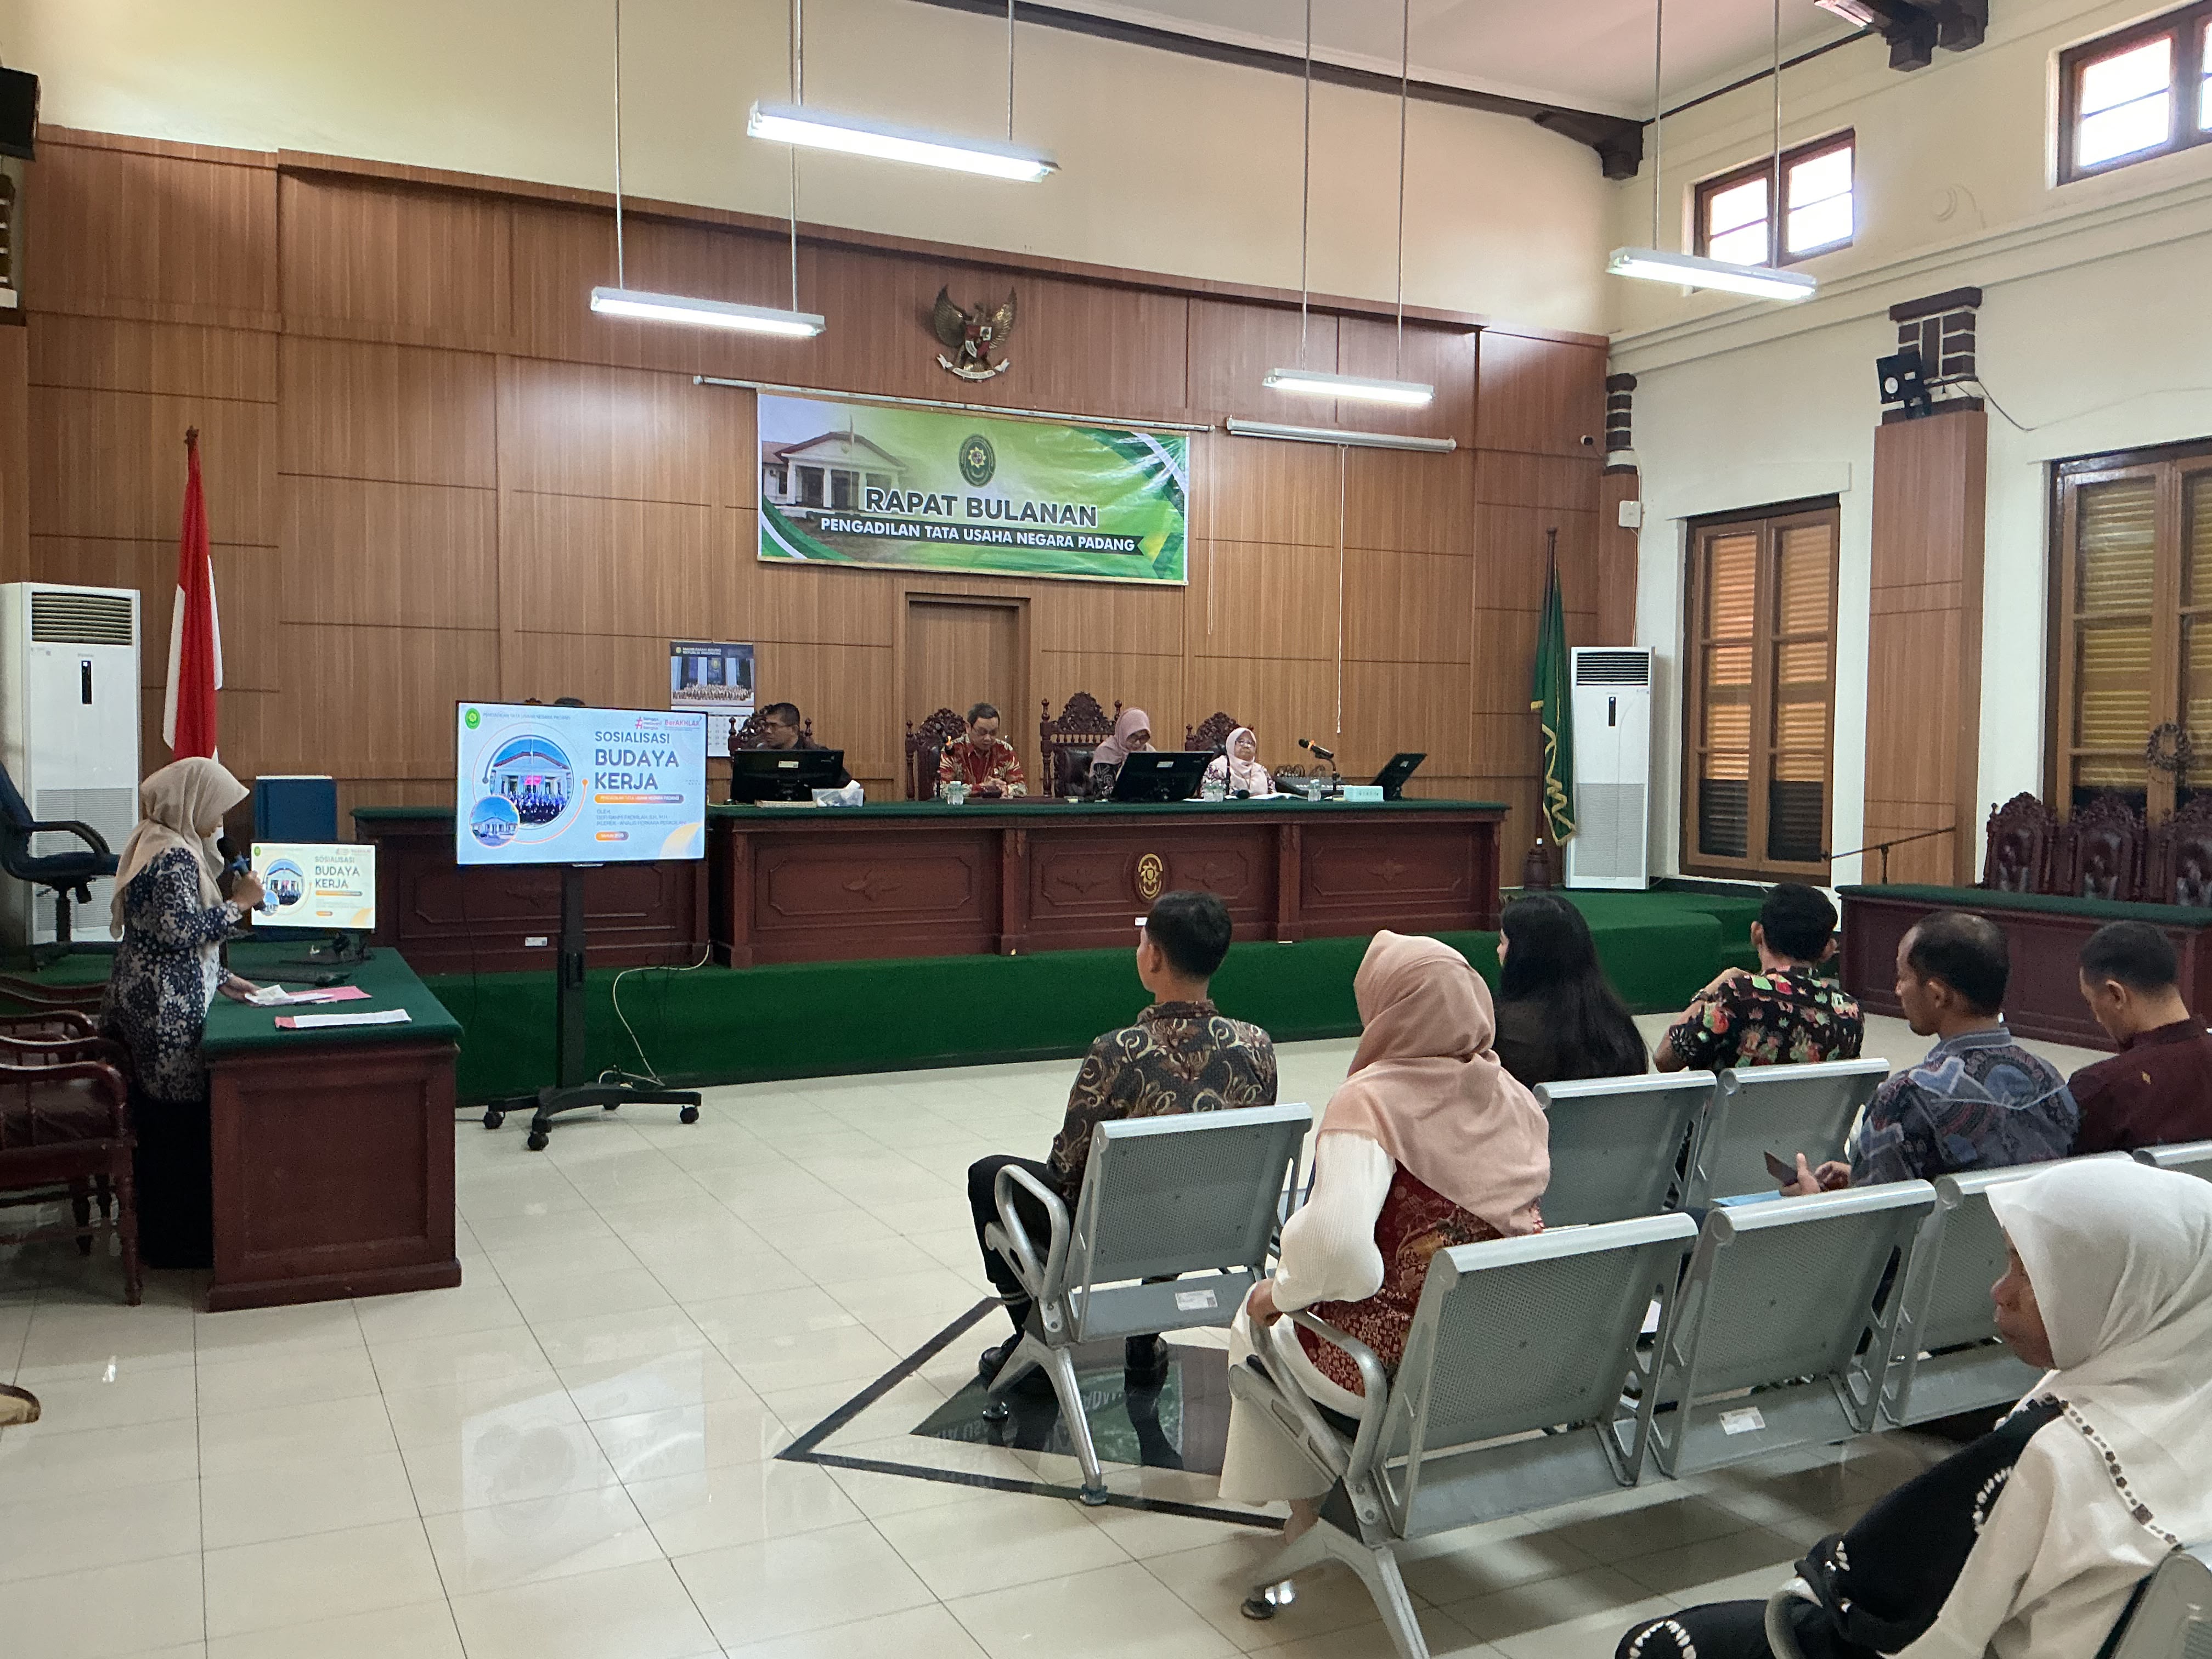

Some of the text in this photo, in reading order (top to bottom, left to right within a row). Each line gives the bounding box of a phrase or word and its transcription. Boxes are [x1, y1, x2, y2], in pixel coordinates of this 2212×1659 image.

[865, 488, 1096, 526] RAPAT BULANAN
[821, 517, 1135, 551] PENGADILAN TATA USAHA NEGARA PADANG
[595, 731, 670, 744] SOSIALISASI
[595, 749, 680, 768] BUDAYA
[595, 772, 658, 789] KERJA
[315, 866, 360, 877] BUDAYA
[315, 878, 348, 889] KERJA
